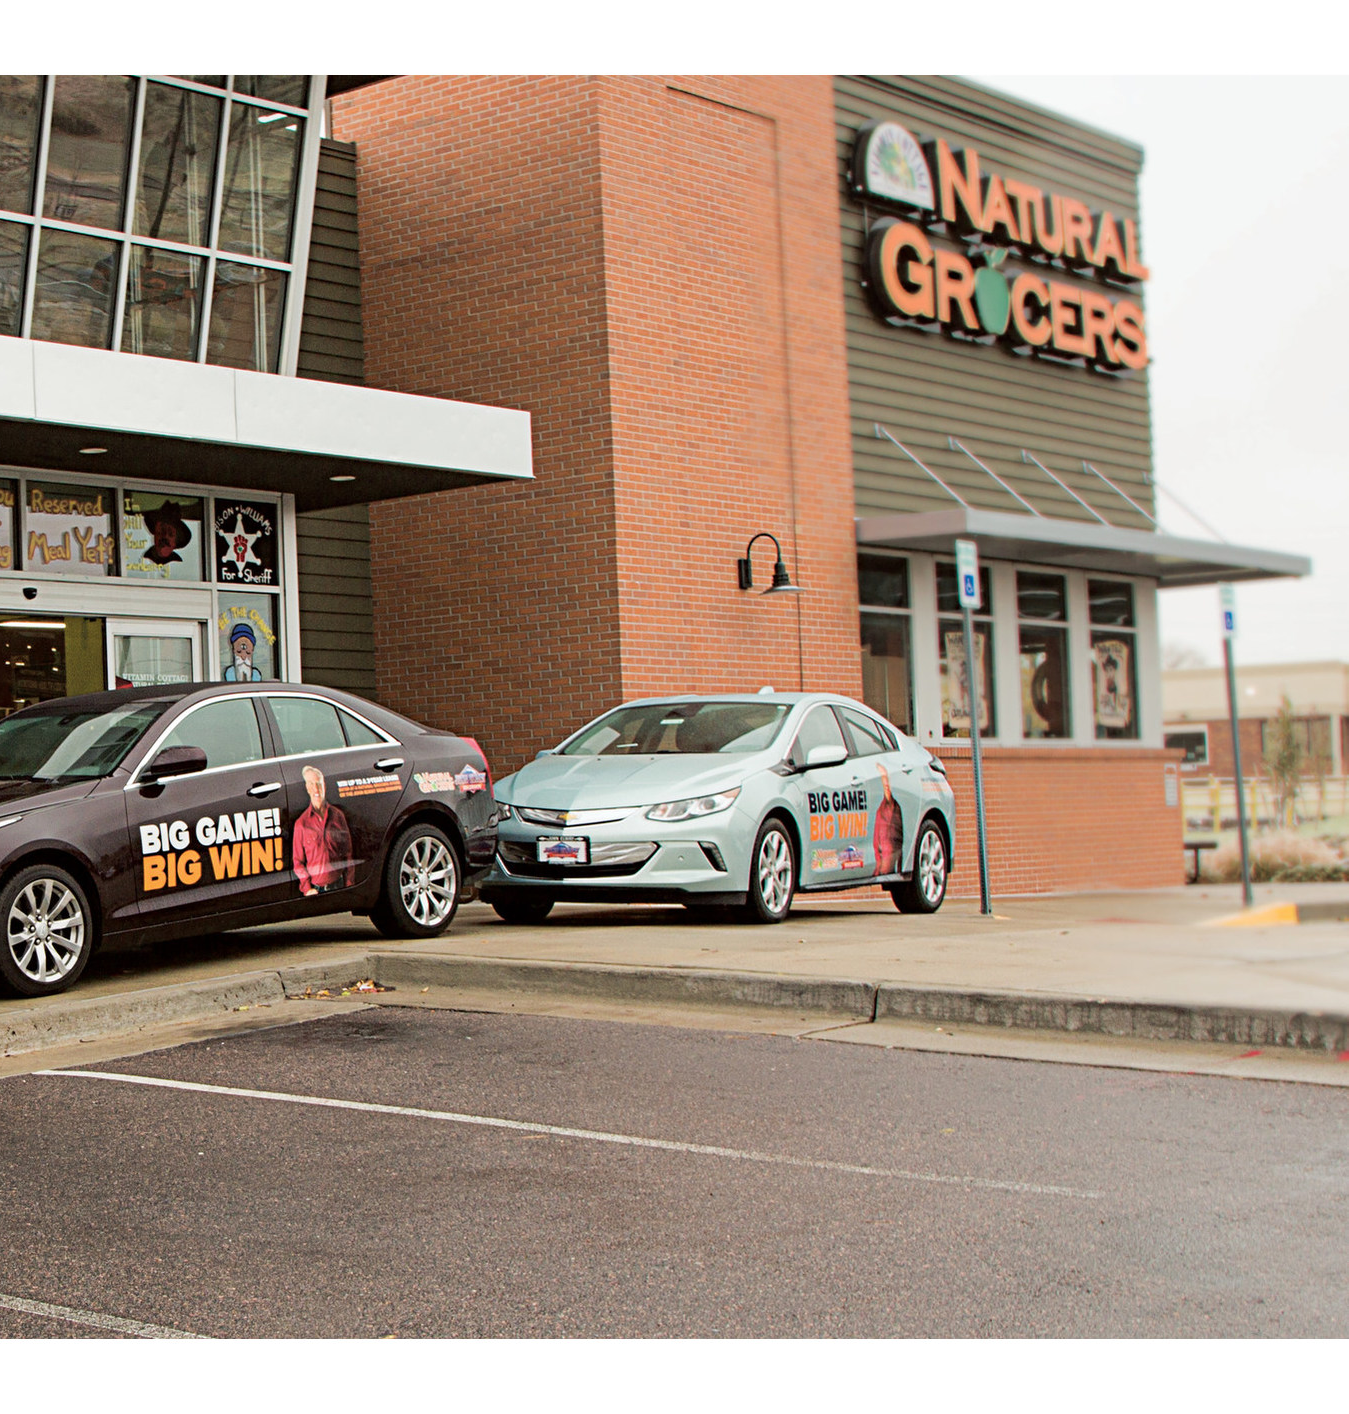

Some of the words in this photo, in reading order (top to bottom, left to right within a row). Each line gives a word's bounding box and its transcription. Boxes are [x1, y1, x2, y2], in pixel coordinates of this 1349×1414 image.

[937, 137, 1149, 281] NATURAL
[881, 222, 1148, 370] GROCERS
[31, 488, 105, 516] Reserved
[240, 504, 272, 536] WILLIAMS
[27, 530, 72, 565] Meal
[73, 526, 115, 564] Yet?
[222, 567, 236, 580] For
[243, 568, 272, 584] Sheriff
[122, 673, 155, 682] VITAMIN
[808, 792, 829, 813] BIG
[832, 790, 867, 811] GAME!
[139, 820, 190, 854] BIG
[195, 808, 282, 846] GAME!
[810, 814, 835, 842] BIG
[838, 812, 869, 839] WIN!
[142, 849, 202, 892] BIG
[209, 837, 284, 880] WIN!
